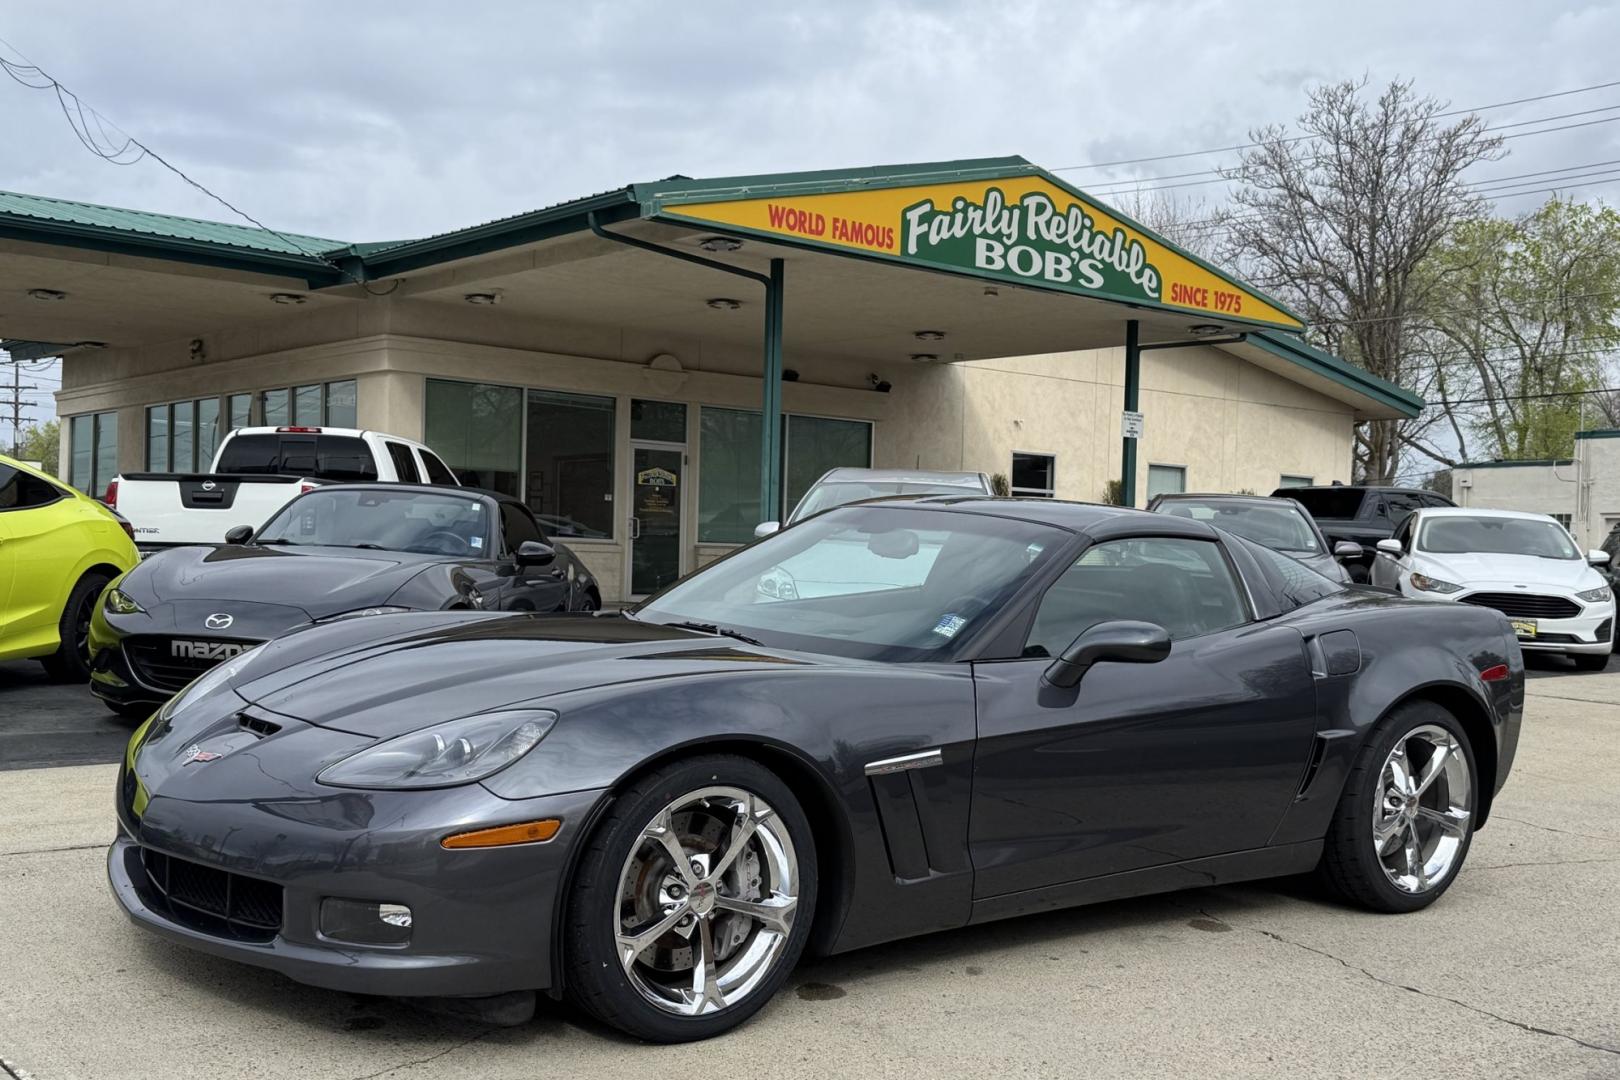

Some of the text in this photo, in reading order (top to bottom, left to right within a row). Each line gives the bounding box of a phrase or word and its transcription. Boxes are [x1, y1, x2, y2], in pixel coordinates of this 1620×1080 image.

[768, 204, 894, 249] WORLD FAMOUS
[906, 191, 1159, 298] Fairly Reliable
[975, 237, 1104, 289] BOB'S
[1171, 282, 1242, 314] SINCE 1975
